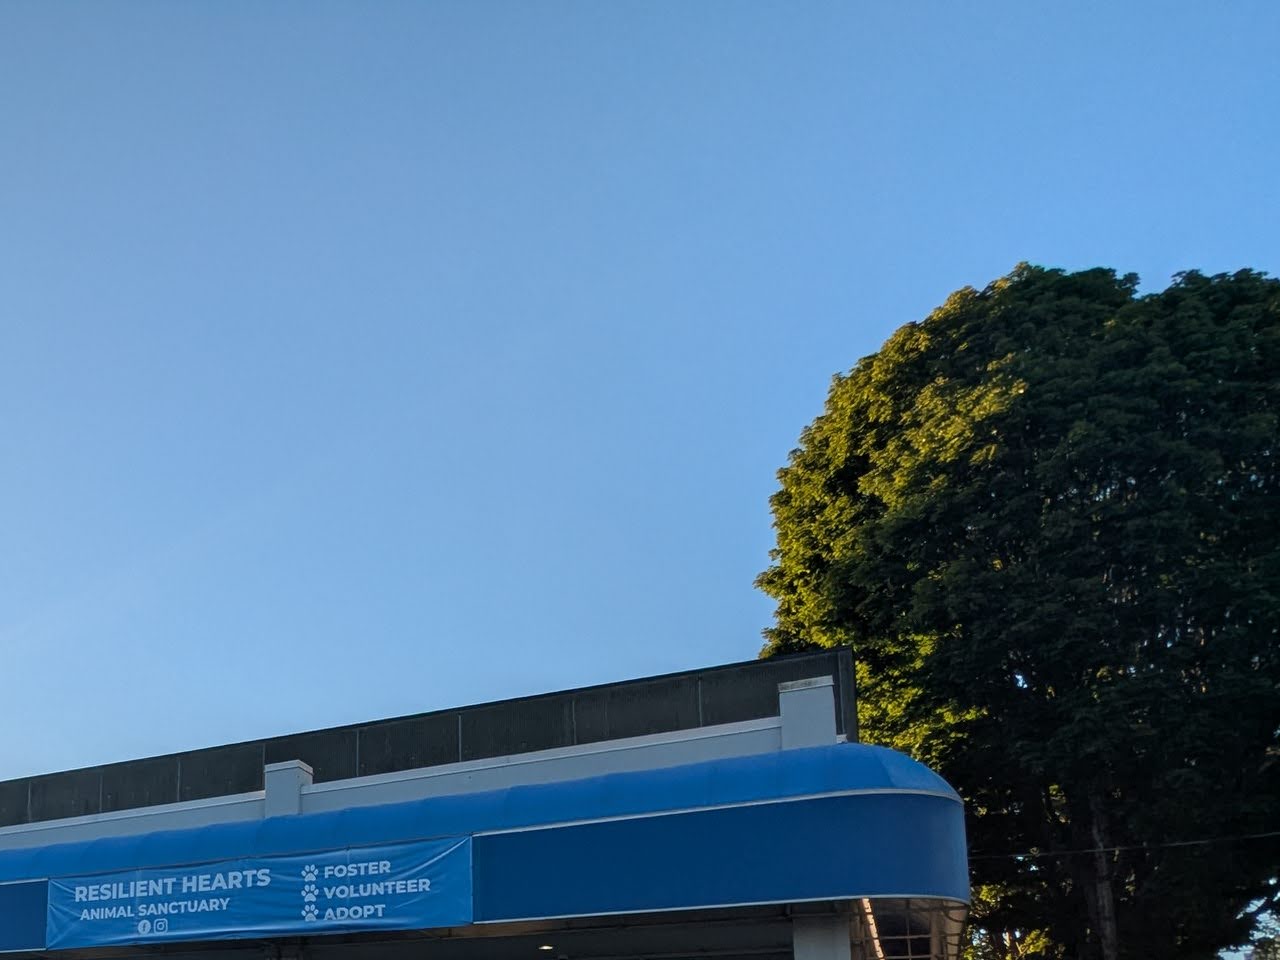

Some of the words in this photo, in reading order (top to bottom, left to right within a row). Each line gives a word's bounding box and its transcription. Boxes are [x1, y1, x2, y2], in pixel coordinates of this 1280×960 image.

[324, 860, 391, 879] FOSTER
[75, 877, 177, 903] RESILIENT
[182, 868, 271, 893] HEARTS
[323, 878, 431, 899] VOLUNTEER
[80, 905, 135, 921] ANIMAL
[138, 897, 231, 917] SANCTUARY
[323, 904, 386, 921] ADOPT
